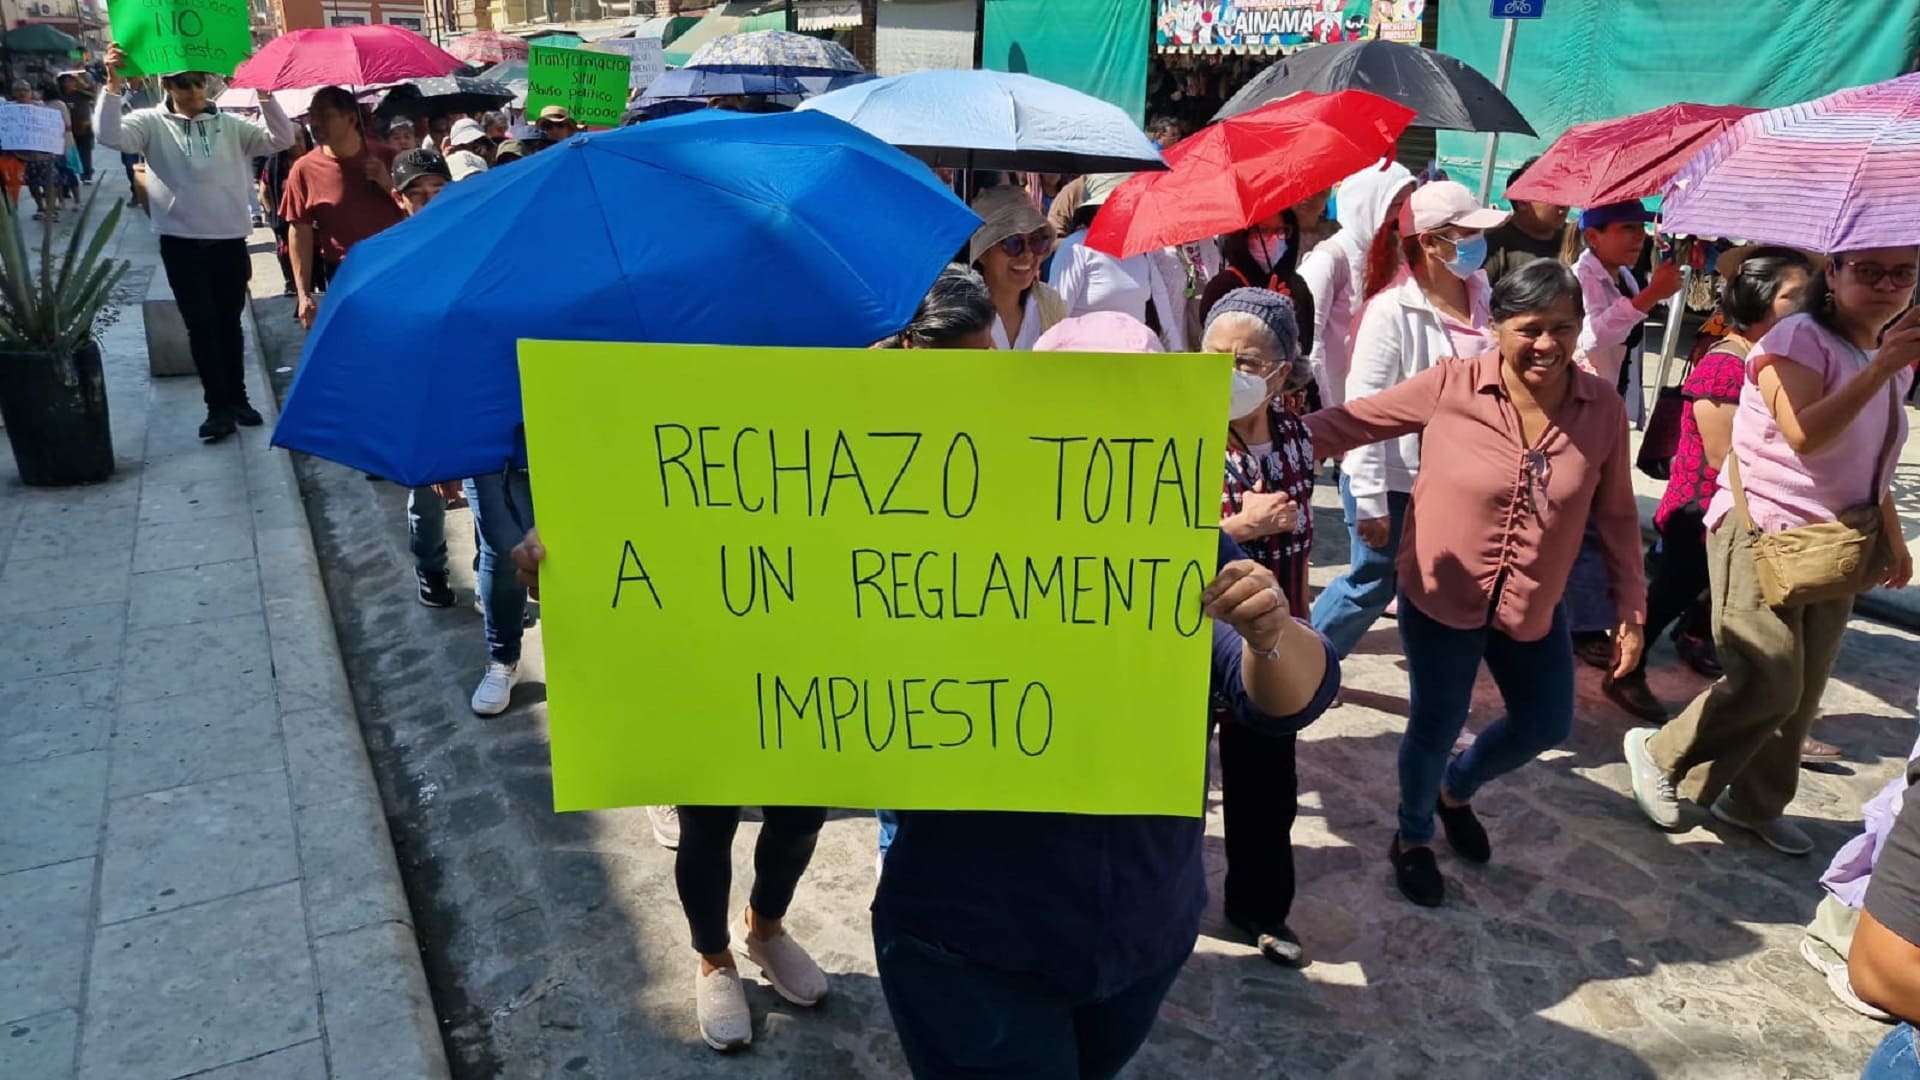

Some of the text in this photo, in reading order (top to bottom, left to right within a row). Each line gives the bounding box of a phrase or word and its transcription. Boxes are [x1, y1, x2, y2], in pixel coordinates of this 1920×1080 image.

[155, 9, 203, 37] NO
[655, 424, 1219, 530] RECHAZO TOTAL
[613, 541, 1205, 636] A UN REGLAMENTO
[757, 673, 1052, 756] IMPUESTO
